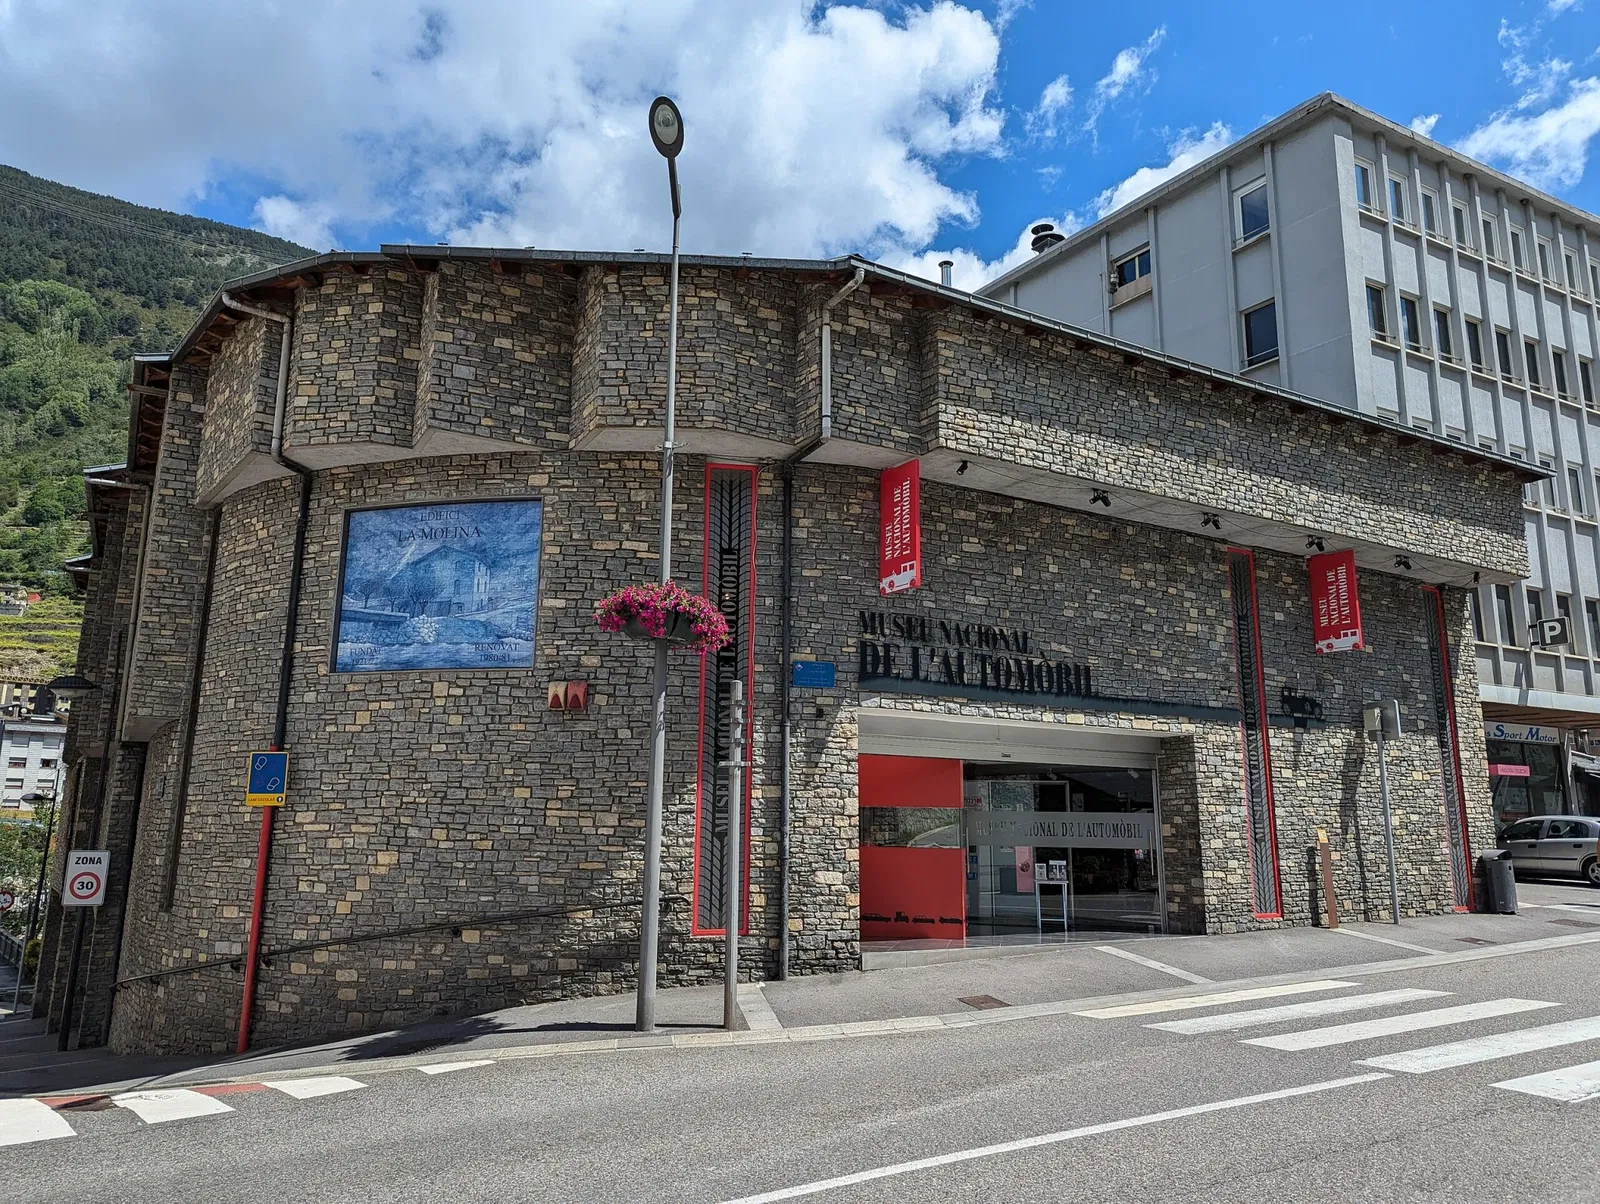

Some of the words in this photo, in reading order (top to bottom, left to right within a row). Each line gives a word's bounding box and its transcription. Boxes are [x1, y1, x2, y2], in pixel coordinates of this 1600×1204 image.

[893, 486, 901, 502] DE
[420, 510, 460, 521] EDIFICI
[398, 529, 416, 542] LA
[420, 525, 481, 540] MOLINA
[893, 504, 901, 558] NACIONAL
[885, 522, 893, 560] MUSEU
[1326, 569, 1336, 582] DE
[1318, 597, 1329, 627] MUSEU
[1327, 582, 1340, 626] NACIONAL
[859, 611, 932, 642] MUSEU
[940, 620, 1034, 654] NACIONAL
[1543, 621, 1562, 644] P
[719, 662, 735, 682] DE
[859, 640, 900, 679] DE
[911, 646, 1094, 697] L'AUTOMÒBIL
[1493, 724, 1522, 740] Sport
[1525, 727, 1556, 742] Motor
[1062, 822, 1074, 837] DE
[74, 856, 102, 865] ZONA
[76, 881, 94, 891] 30
